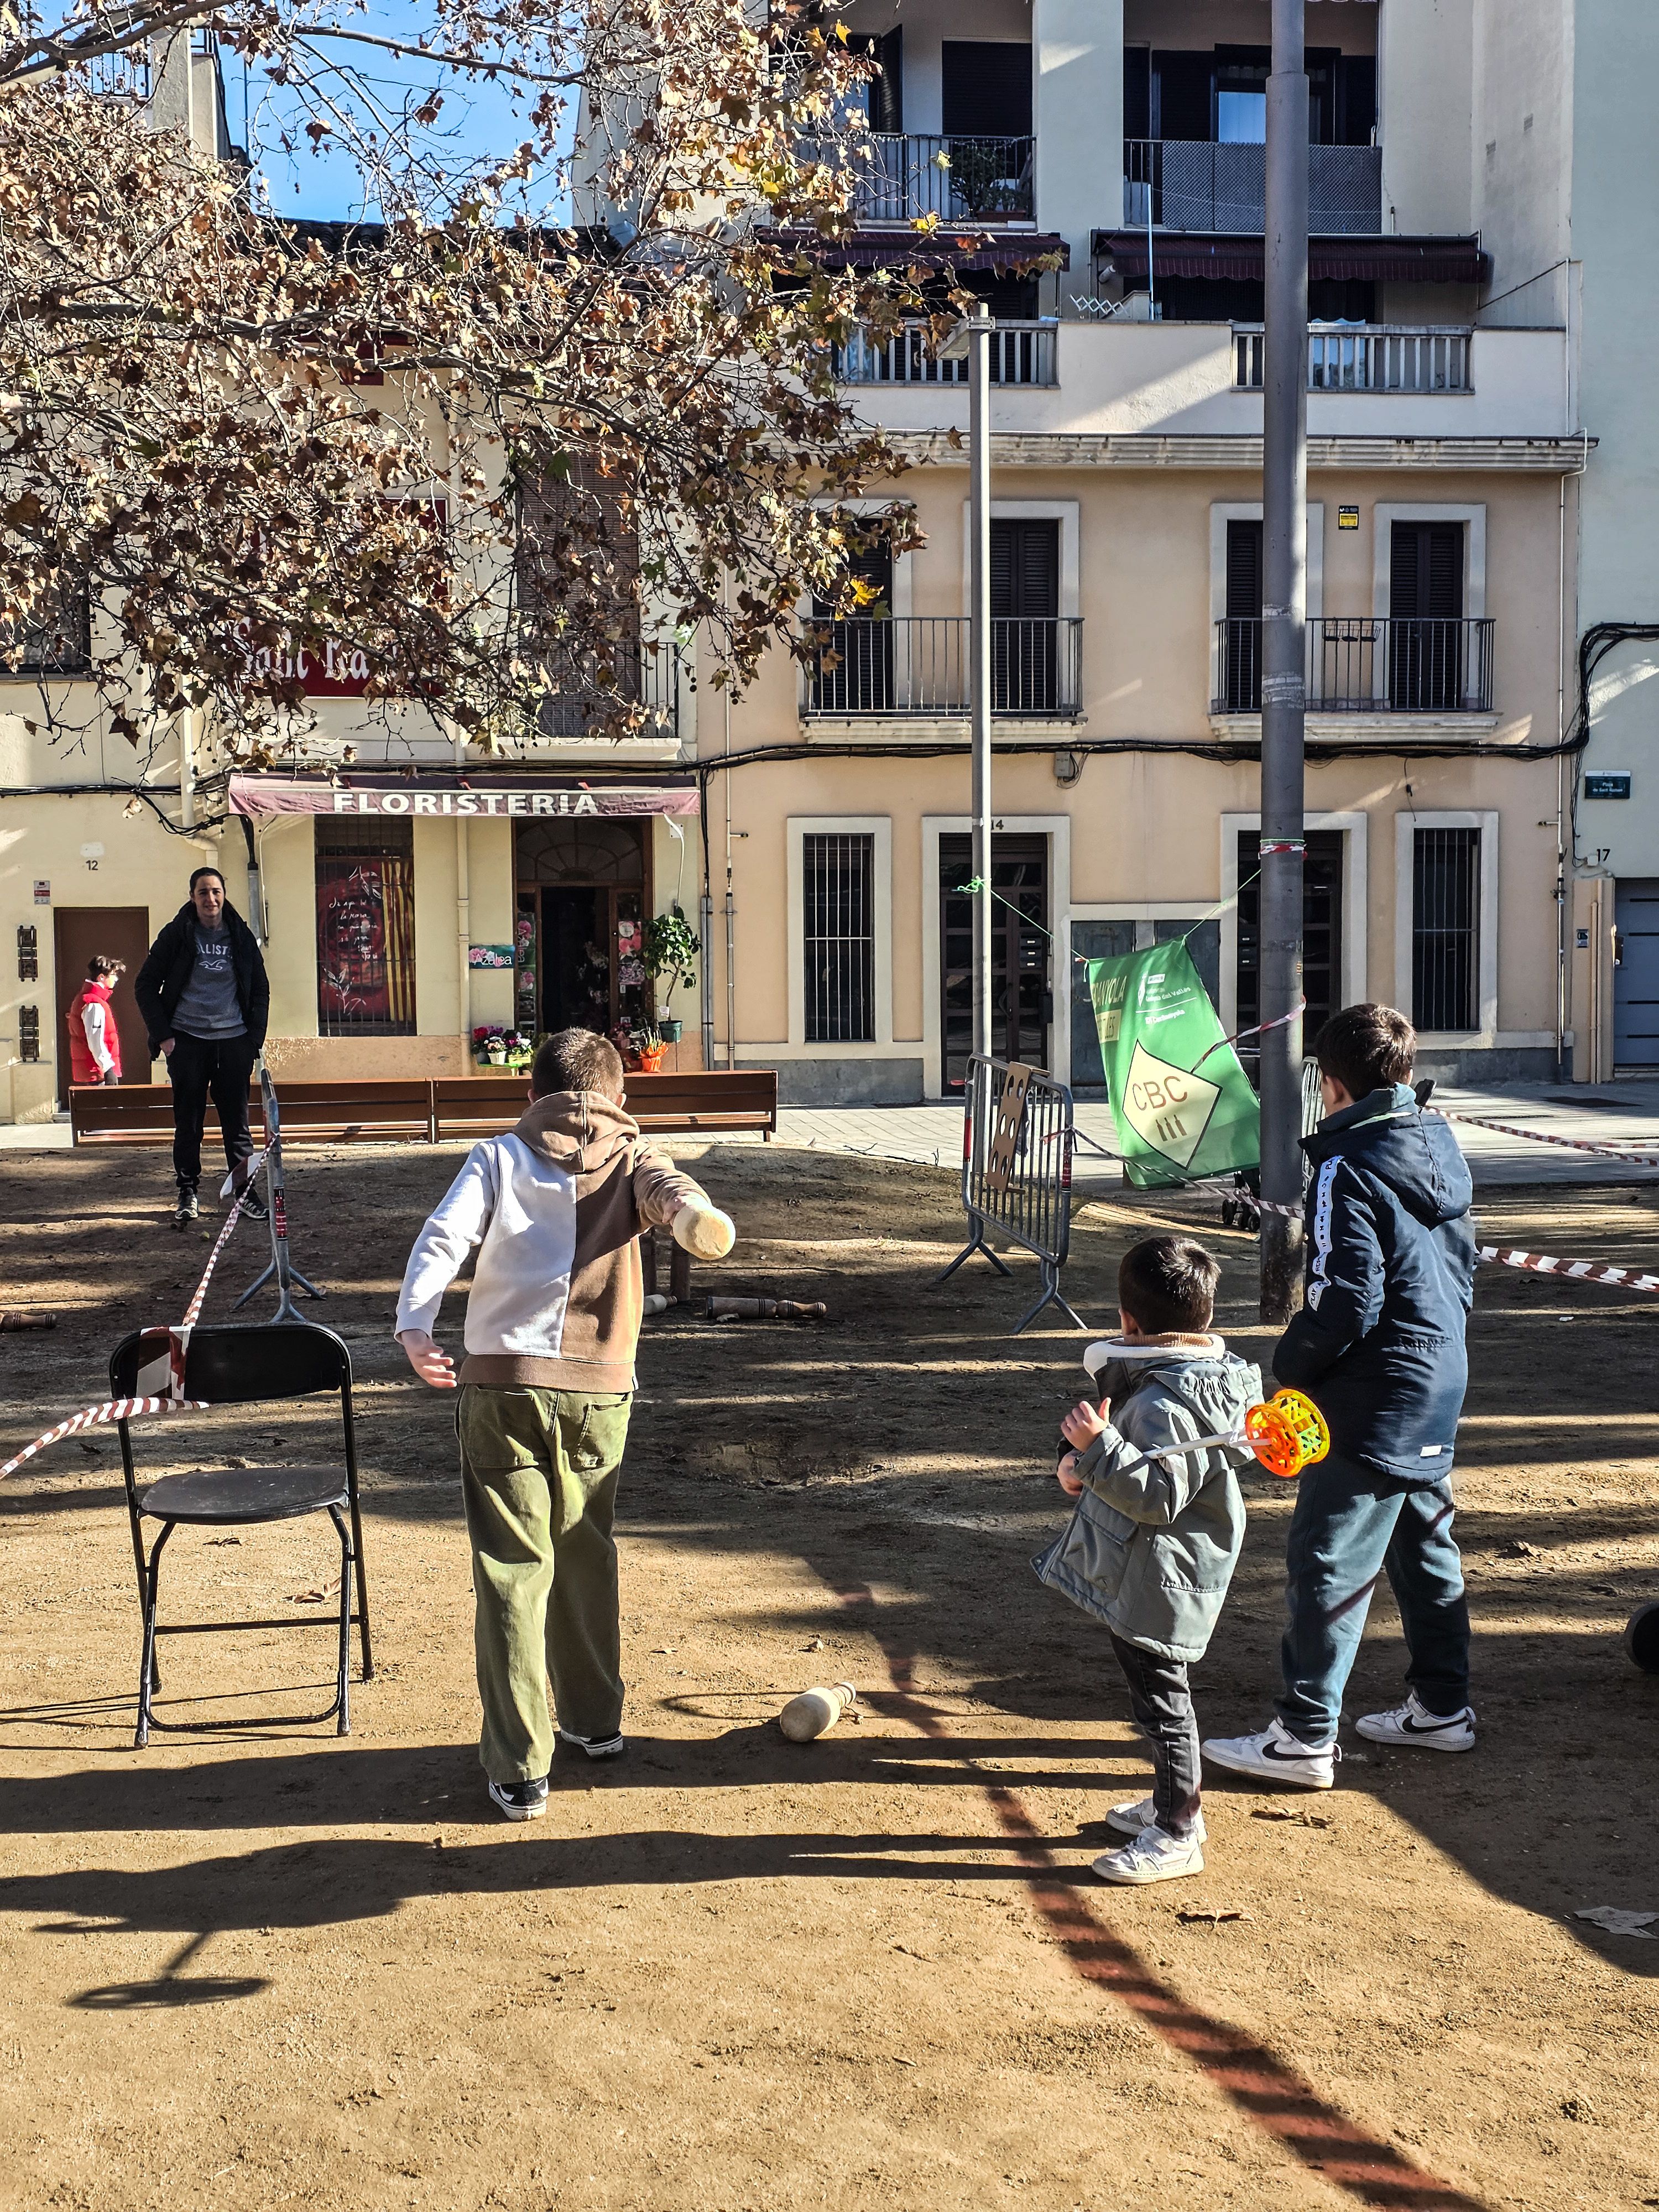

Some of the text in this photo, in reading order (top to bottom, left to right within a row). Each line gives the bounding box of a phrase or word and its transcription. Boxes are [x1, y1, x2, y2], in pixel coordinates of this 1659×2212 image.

[334, 794, 598, 815] FLORISTERIA
[991, 819, 1004, 830] 14
[1597, 848, 1611, 862] 17
[86, 859, 98, 871] 12
[196, 940, 233, 959] LLIST
[474, 953, 513, 966] Azalea
[1133, 1076, 1188, 1111] CBC
